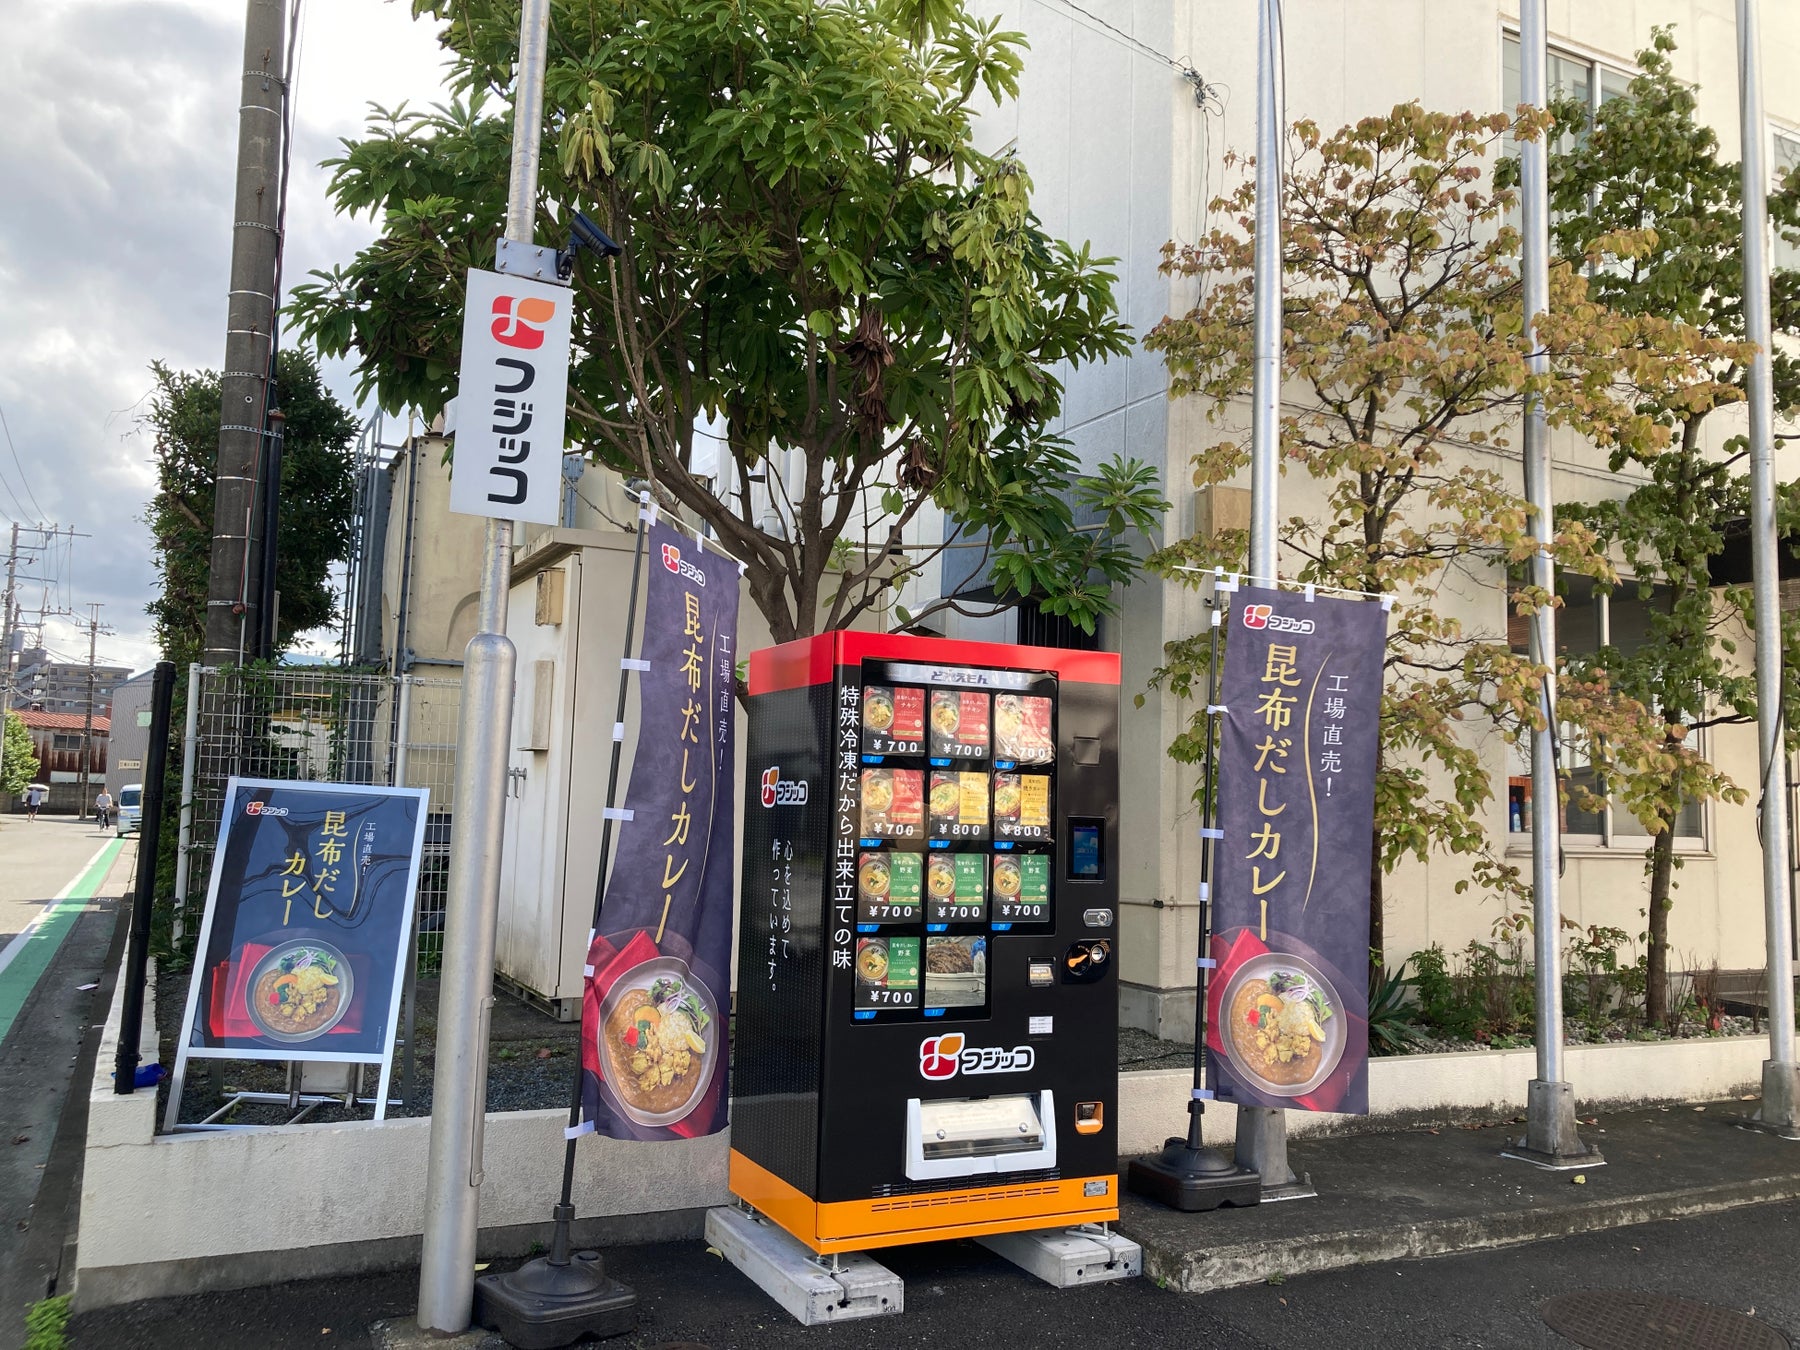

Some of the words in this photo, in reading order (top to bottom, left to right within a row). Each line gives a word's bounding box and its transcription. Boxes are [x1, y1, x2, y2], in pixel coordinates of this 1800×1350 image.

[487, 357, 535, 505] フジッコ
[680, 560, 705, 587] フジッコ
[1269, 615, 1315, 634] フジッコ
[873, 739, 918, 753] ¥700
[1320, 675, 1349, 797] 工場直売！
[943, 743, 982, 757] ¥700
[655, 591, 704, 944] 昆布だしカレー
[778, 781, 808, 804] フジッコ
[1246, 643, 1301, 941] 昆布だしカレー
[261, 806, 288, 816] フジッコ
[833, 685, 860, 970] 特殊冷凍だから出来立ての味
[873, 823, 914, 836] ¥700
[939, 823, 980, 836] ¥800
[1002, 824, 1041, 837] ¥800
[314, 811, 349, 919] 昆布だし
[280, 852, 306, 925] カレー
[782, 840, 793, 959] 心を込めて
[768, 838, 781, 991] 作っています。
[869, 905, 912, 918] ¥700
[937, 906, 980, 918] ¥700
[1002, 905, 1041, 916] ¥700
[870, 990, 912, 1004] ¥700
[963, 1048, 1033, 1073] フジッコ
